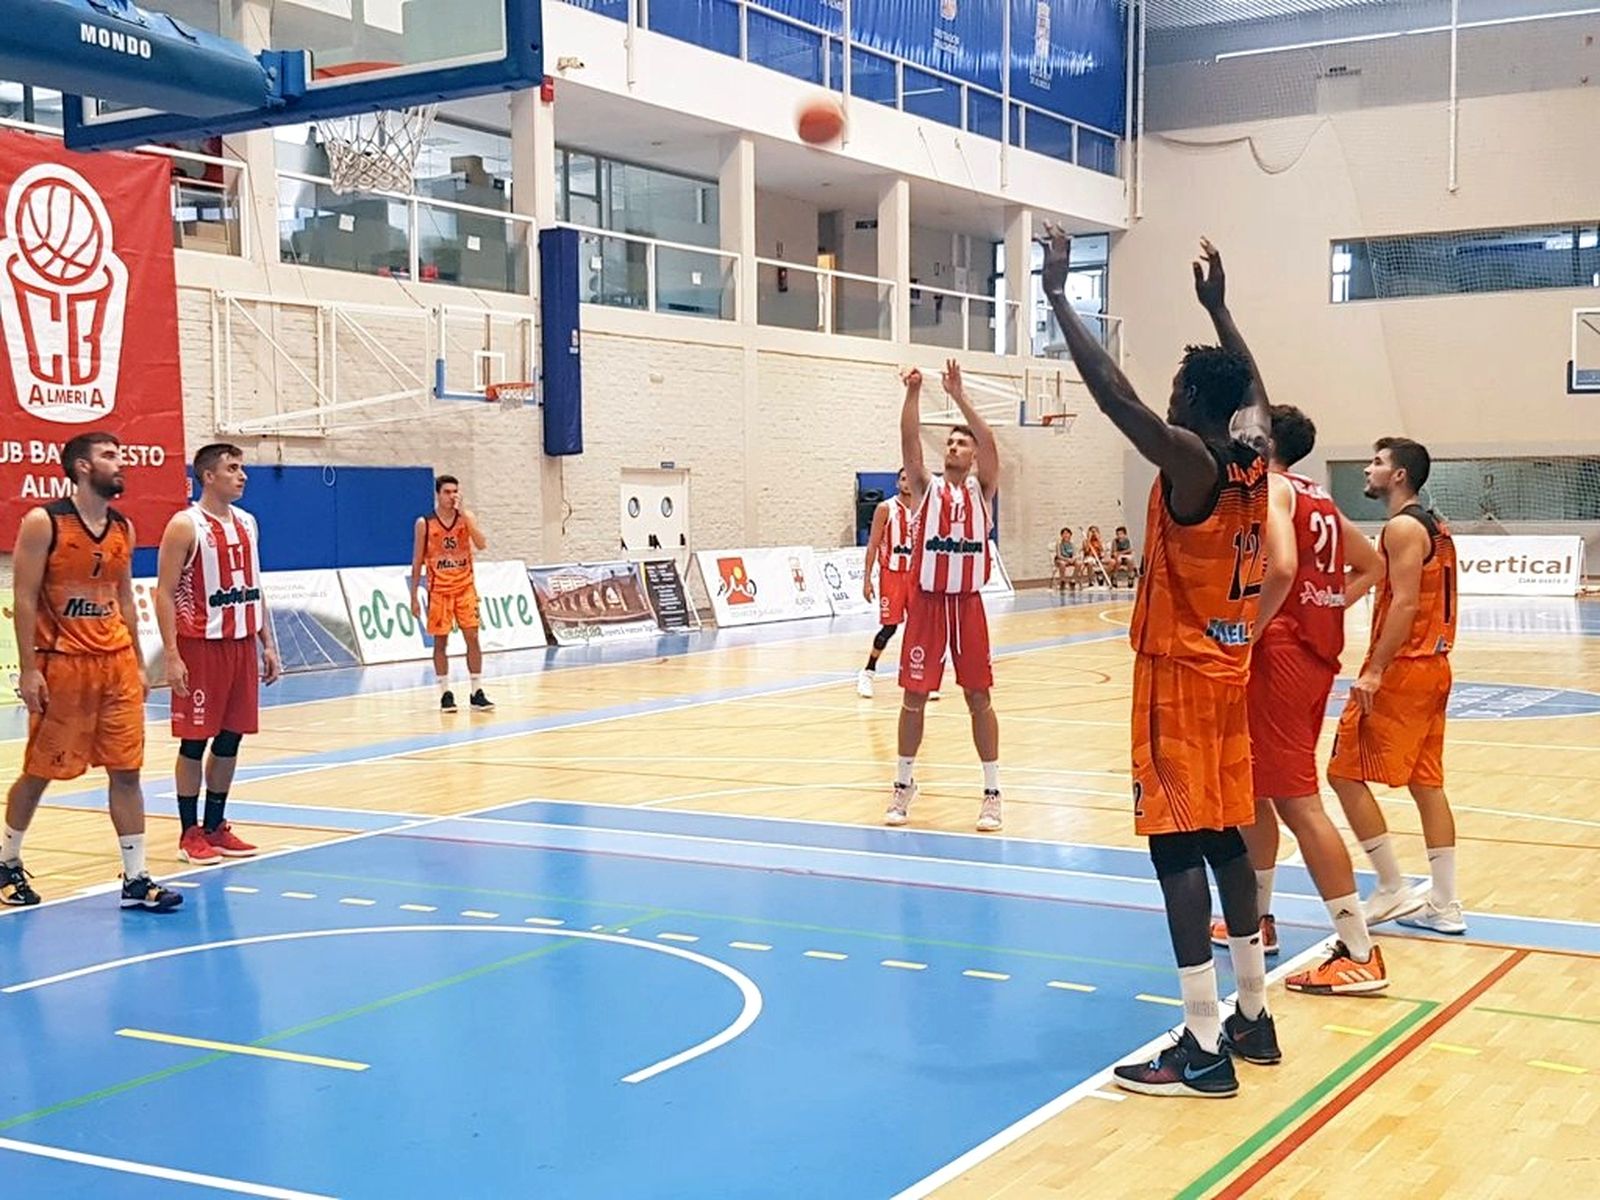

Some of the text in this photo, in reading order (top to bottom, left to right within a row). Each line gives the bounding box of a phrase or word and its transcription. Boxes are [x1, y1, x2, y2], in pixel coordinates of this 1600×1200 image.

[80, 23, 152, 59] MONDO
[28, 384, 106, 410] ALMERIA
[29, 440, 165, 467] BAESTO
[442, 535, 458, 550] 35
[1309, 511, 1338, 573] 21
[89, 551, 103, 578] 7
[227, 544, 245, 570] 11
[1227, 521, 1262, 602] 12
[1459, 555, 1572, 575] vertical
